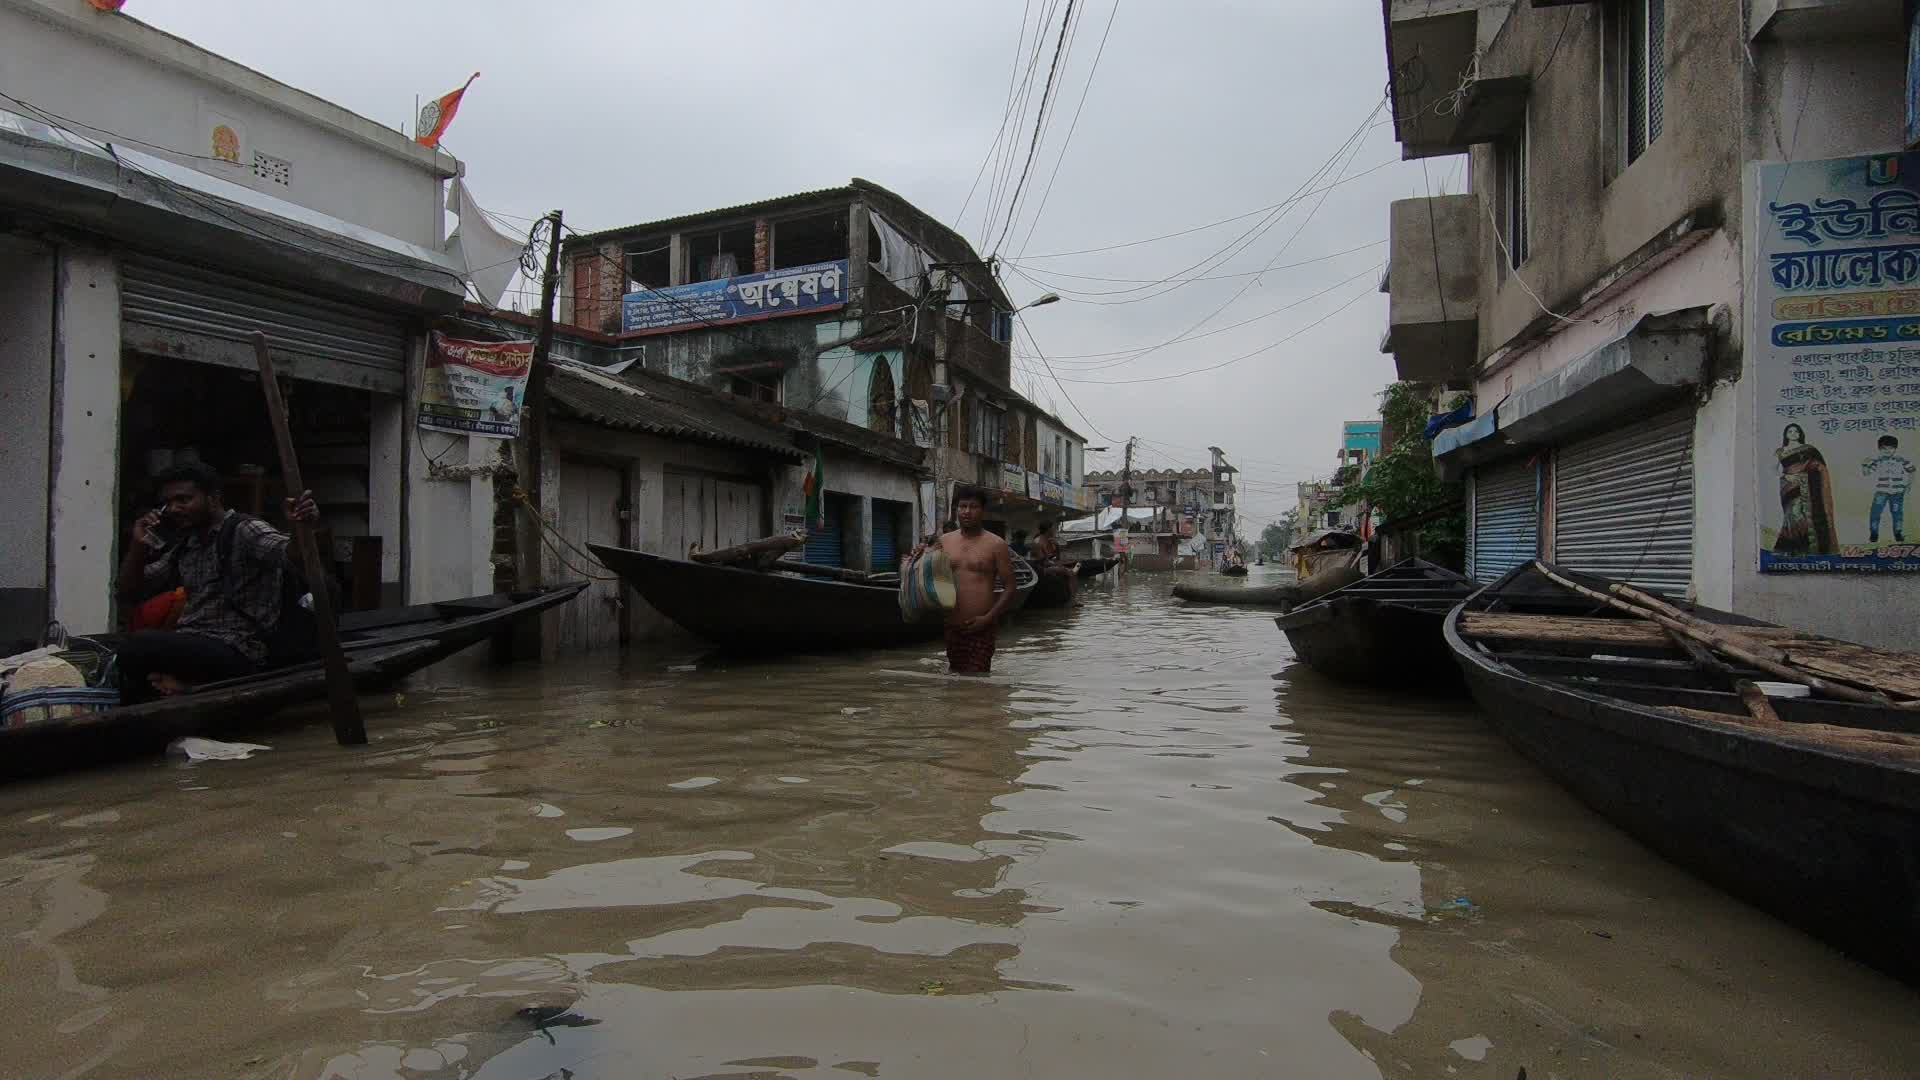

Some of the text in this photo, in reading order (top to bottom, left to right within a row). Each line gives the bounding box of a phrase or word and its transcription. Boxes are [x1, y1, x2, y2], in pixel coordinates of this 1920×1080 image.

[1770, 233, 1920, 288] ক্যালেক
[1778, 325, 1888, 343] রেডিমেড
[1792, 352, 1832, 363] এখানে
